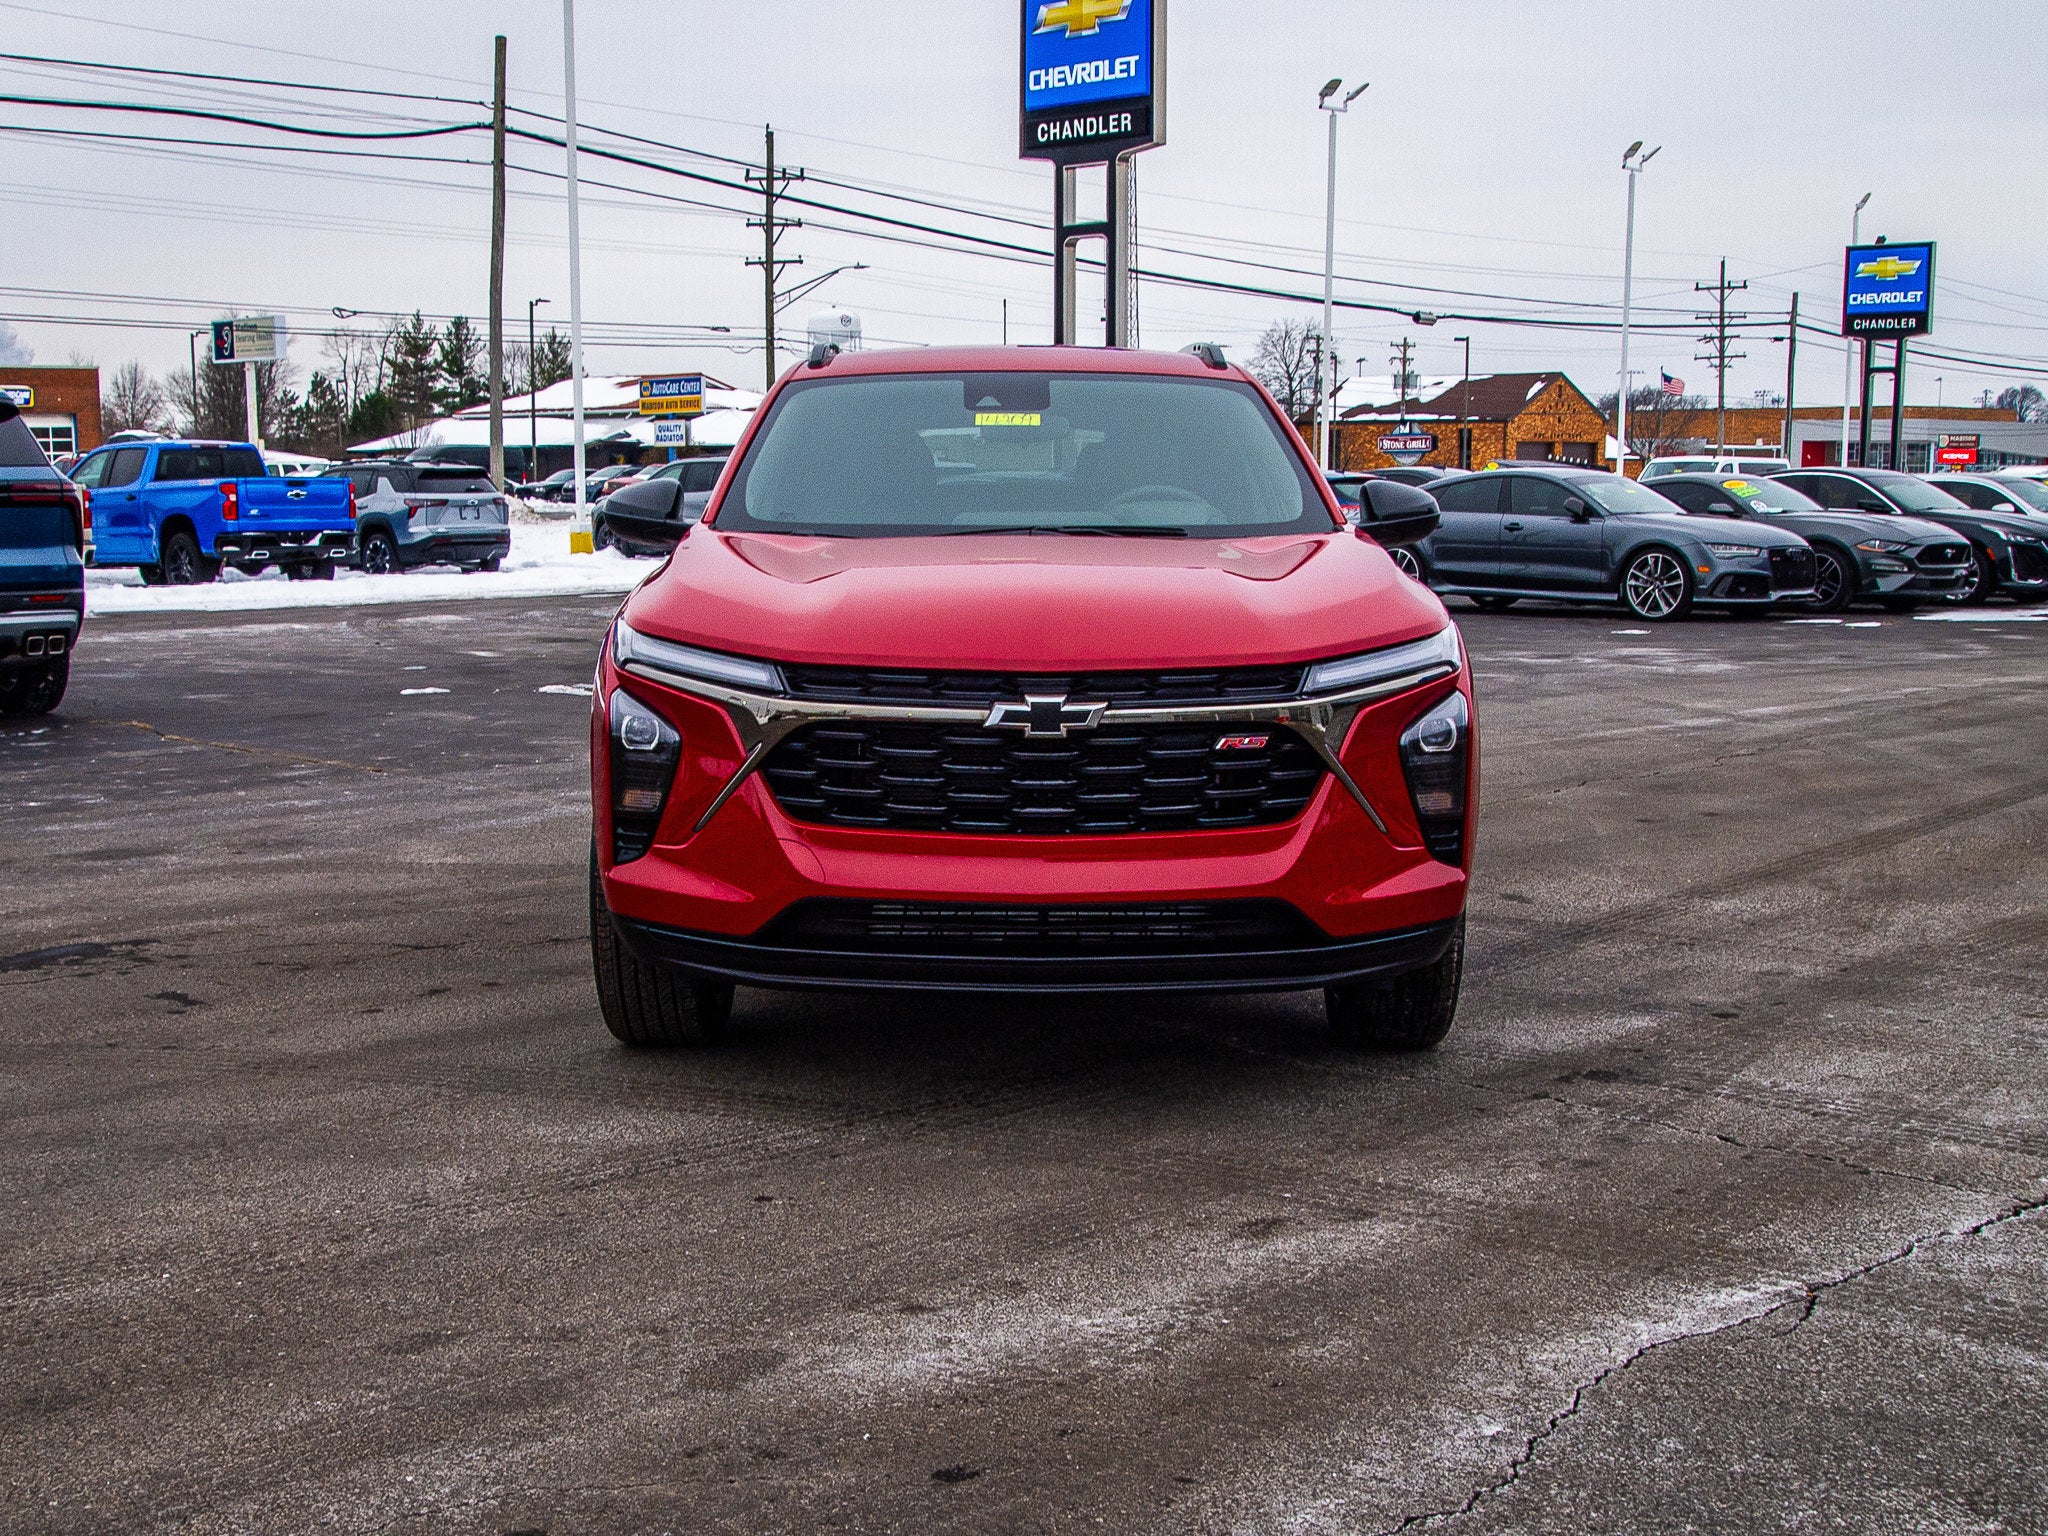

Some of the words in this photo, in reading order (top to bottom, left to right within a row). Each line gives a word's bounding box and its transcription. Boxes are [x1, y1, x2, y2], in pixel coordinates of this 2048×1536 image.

[1029, 54, 1140, 91] CHEVROLET
[1037, 112, 1132, 143] CHANDLER
[1849, 291, 1923, 305] CHEVROLET
[1853, 318, 1916, 329] CHANDLER
[680, 381, 700, 393] CENTER
[665, 401, 678, 409] AUTO
[679, 399, 699, 408] SERVICE
[658, 424, 681, 433] QUALITY
[656, 434, 683, 442] RADIATOR
[1383, 439, 1405, 450] STONE
[1406, 439, 1426, 449] GRILL
[1215, 736, 1268, 749] RS
